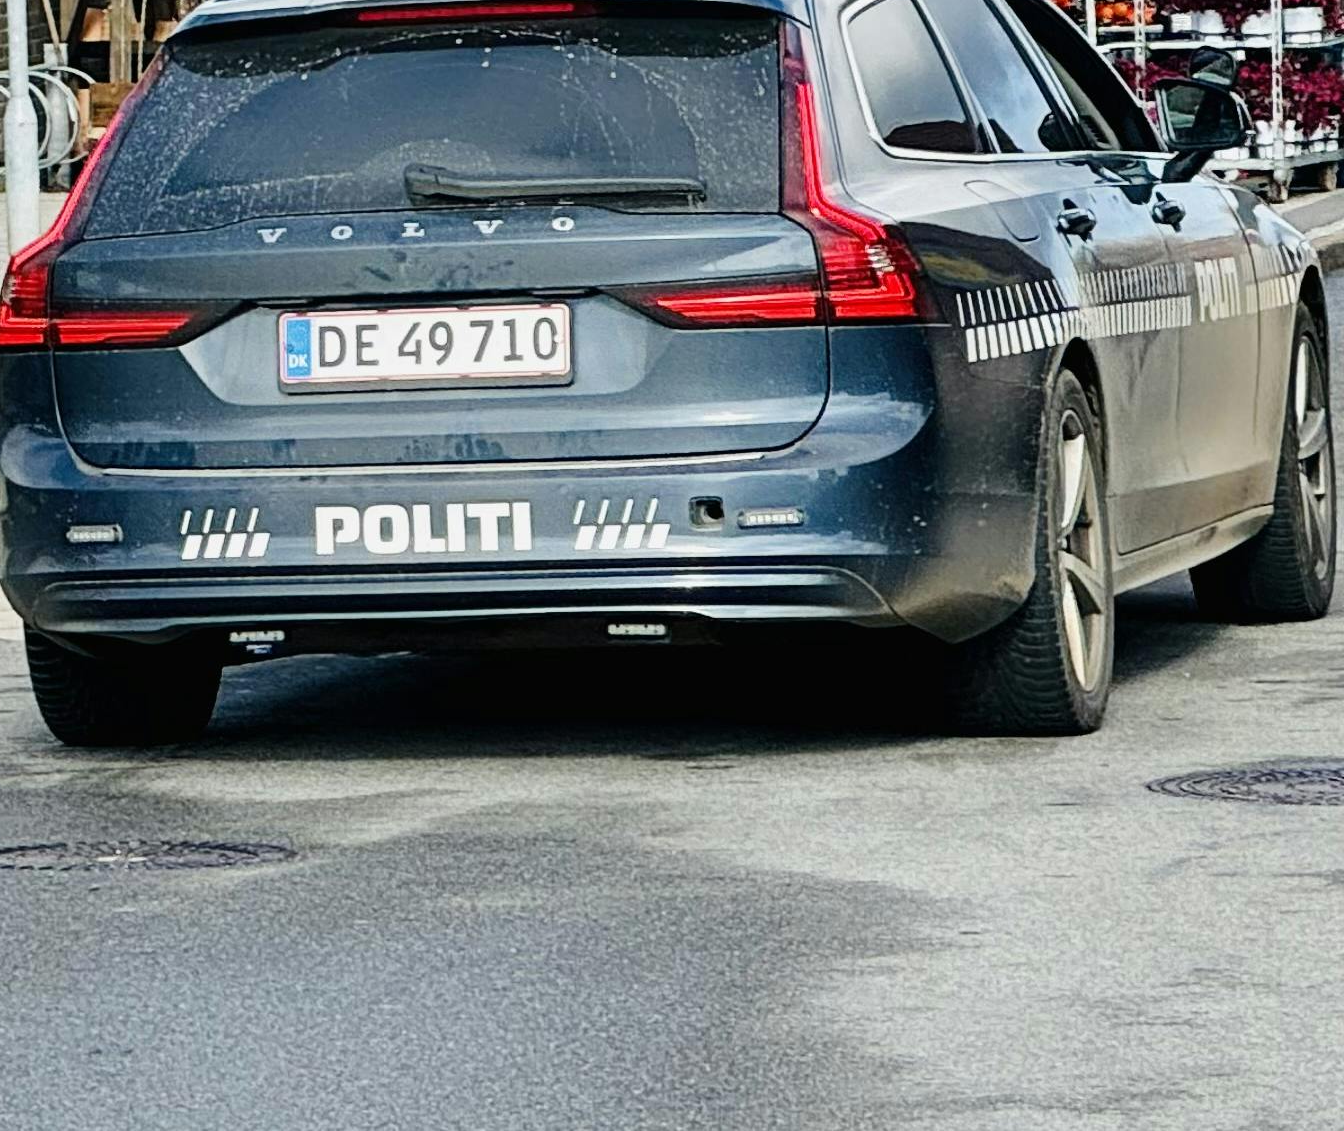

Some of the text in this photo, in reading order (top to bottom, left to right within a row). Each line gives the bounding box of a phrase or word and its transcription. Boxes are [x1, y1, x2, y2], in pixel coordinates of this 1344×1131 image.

[258, 216, 575, 244] VOLVO
[288, 316, 560, 368] DK DE 49 710
[315, 501, 533, 555] POLITI
